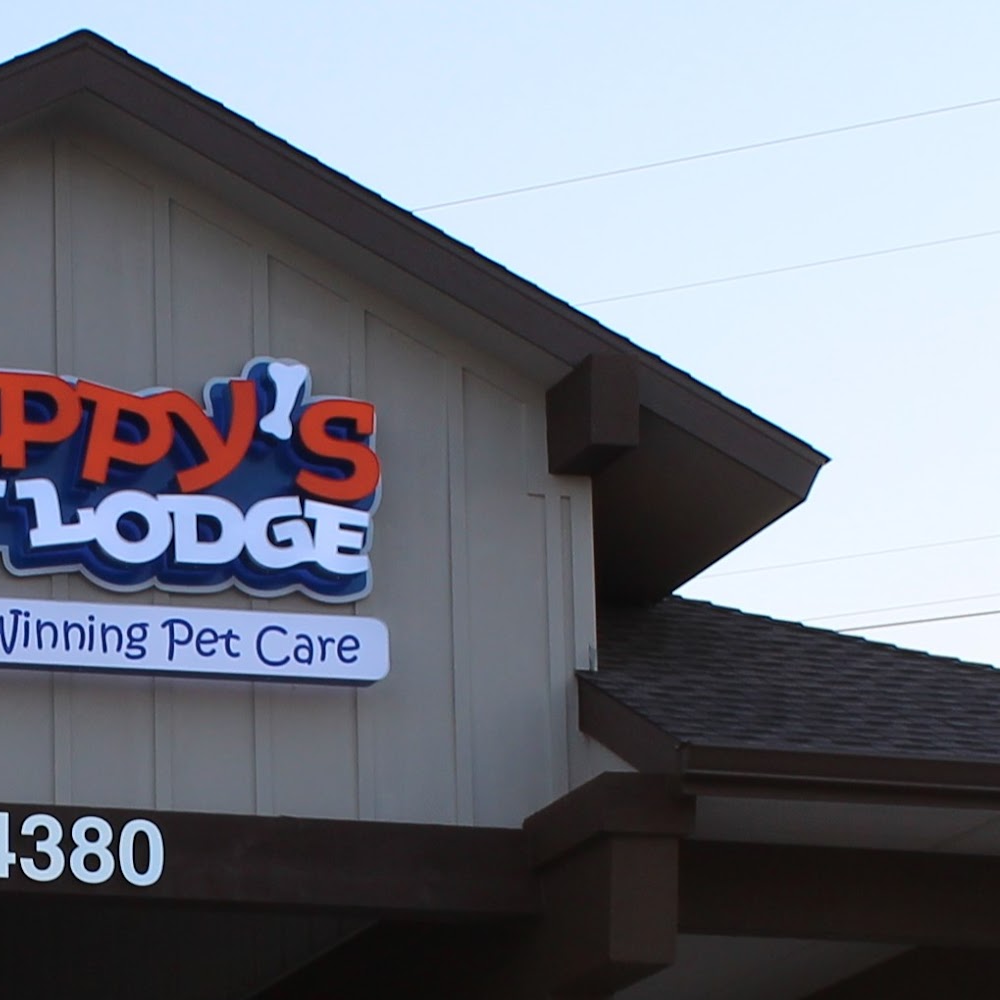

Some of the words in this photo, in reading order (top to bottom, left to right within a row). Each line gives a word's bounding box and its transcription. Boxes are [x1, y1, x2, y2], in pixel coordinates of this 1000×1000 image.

[15, 478, 370, 574] LODGE
[160, 618, 241, 661] Pet
[256, 625, 361, 667] Care
